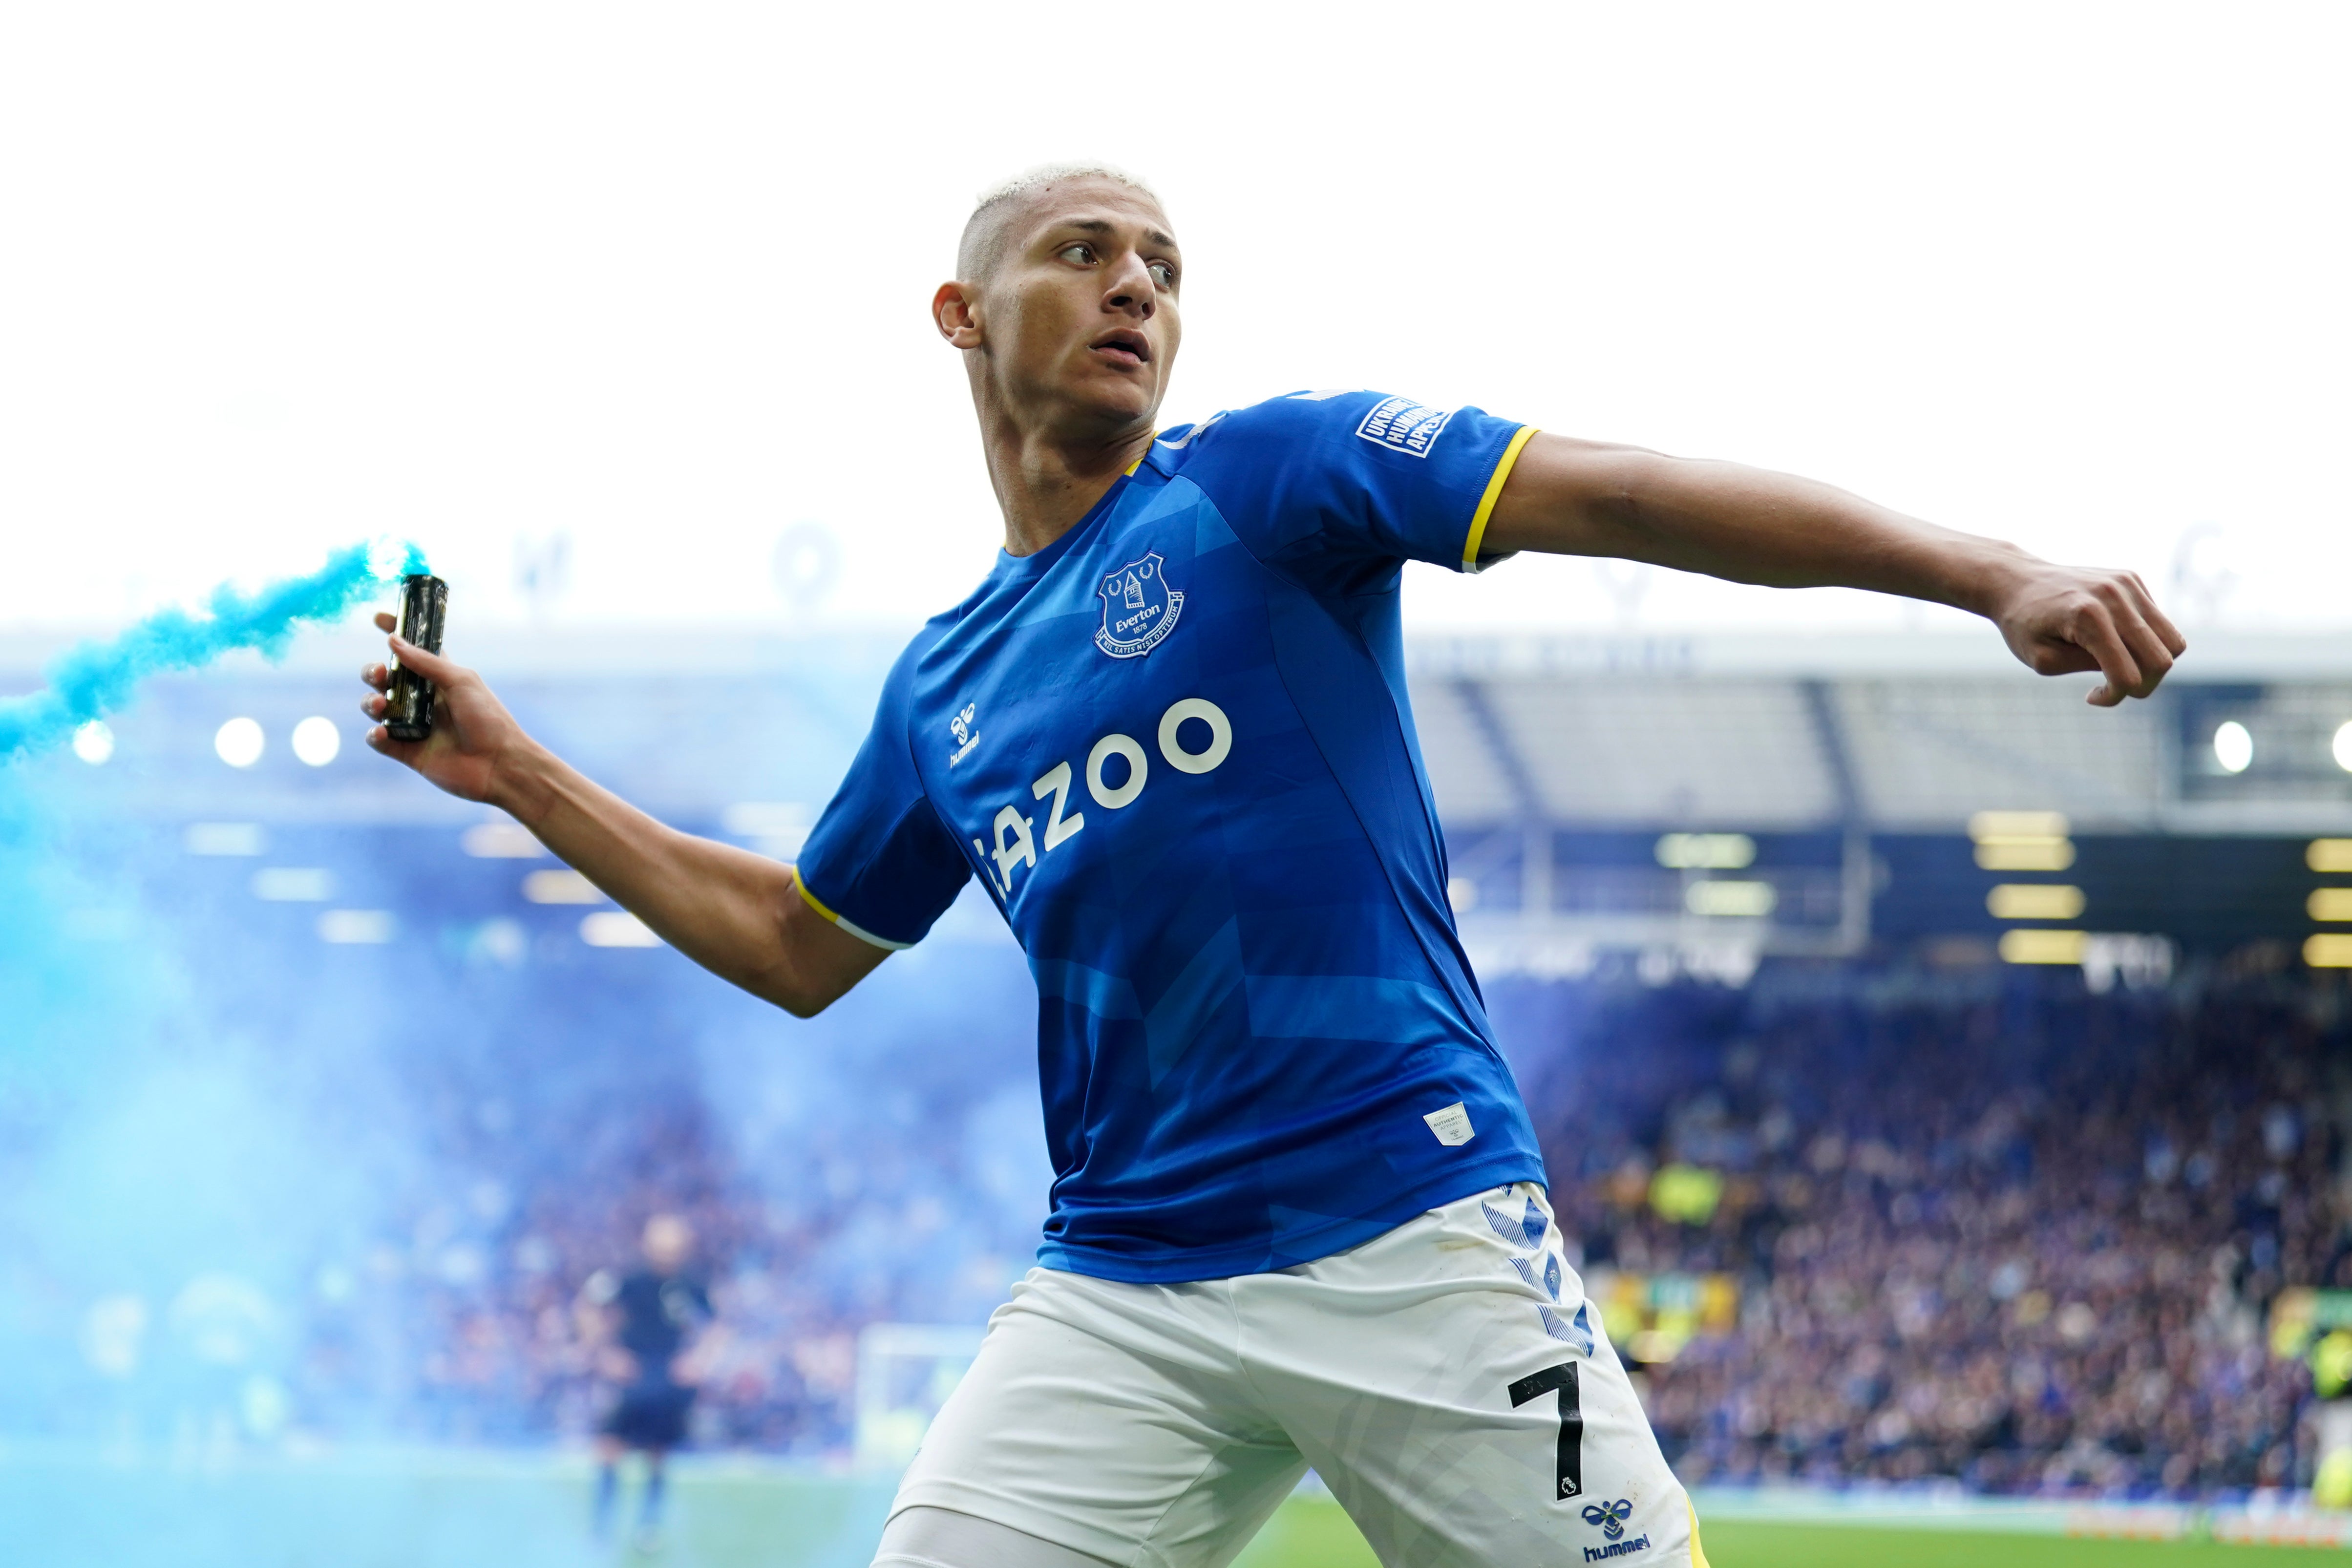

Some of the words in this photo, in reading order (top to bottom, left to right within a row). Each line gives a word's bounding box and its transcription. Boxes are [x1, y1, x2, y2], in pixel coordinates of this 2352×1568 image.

[1365, 399, 1414, 436] UKRAINE
[1406, 411, 1448, 450] APPEAL
[1103, 640, 1113, 651] NIL
[1137, 638, 1154, 651] NISI
[1154, 606, 1178, 639] OPTIMUM
[1116, 604, 1161, 633] Everton
[1133, 622, 1147, 634] 1878
[950, 730, 979, 768] hummel
[1433, 1114, 1463, 1127] AUTHENTIC
[1507, 1361, 1583, 1501] 7
[1584, 1533, 1651, 1562] hummel
